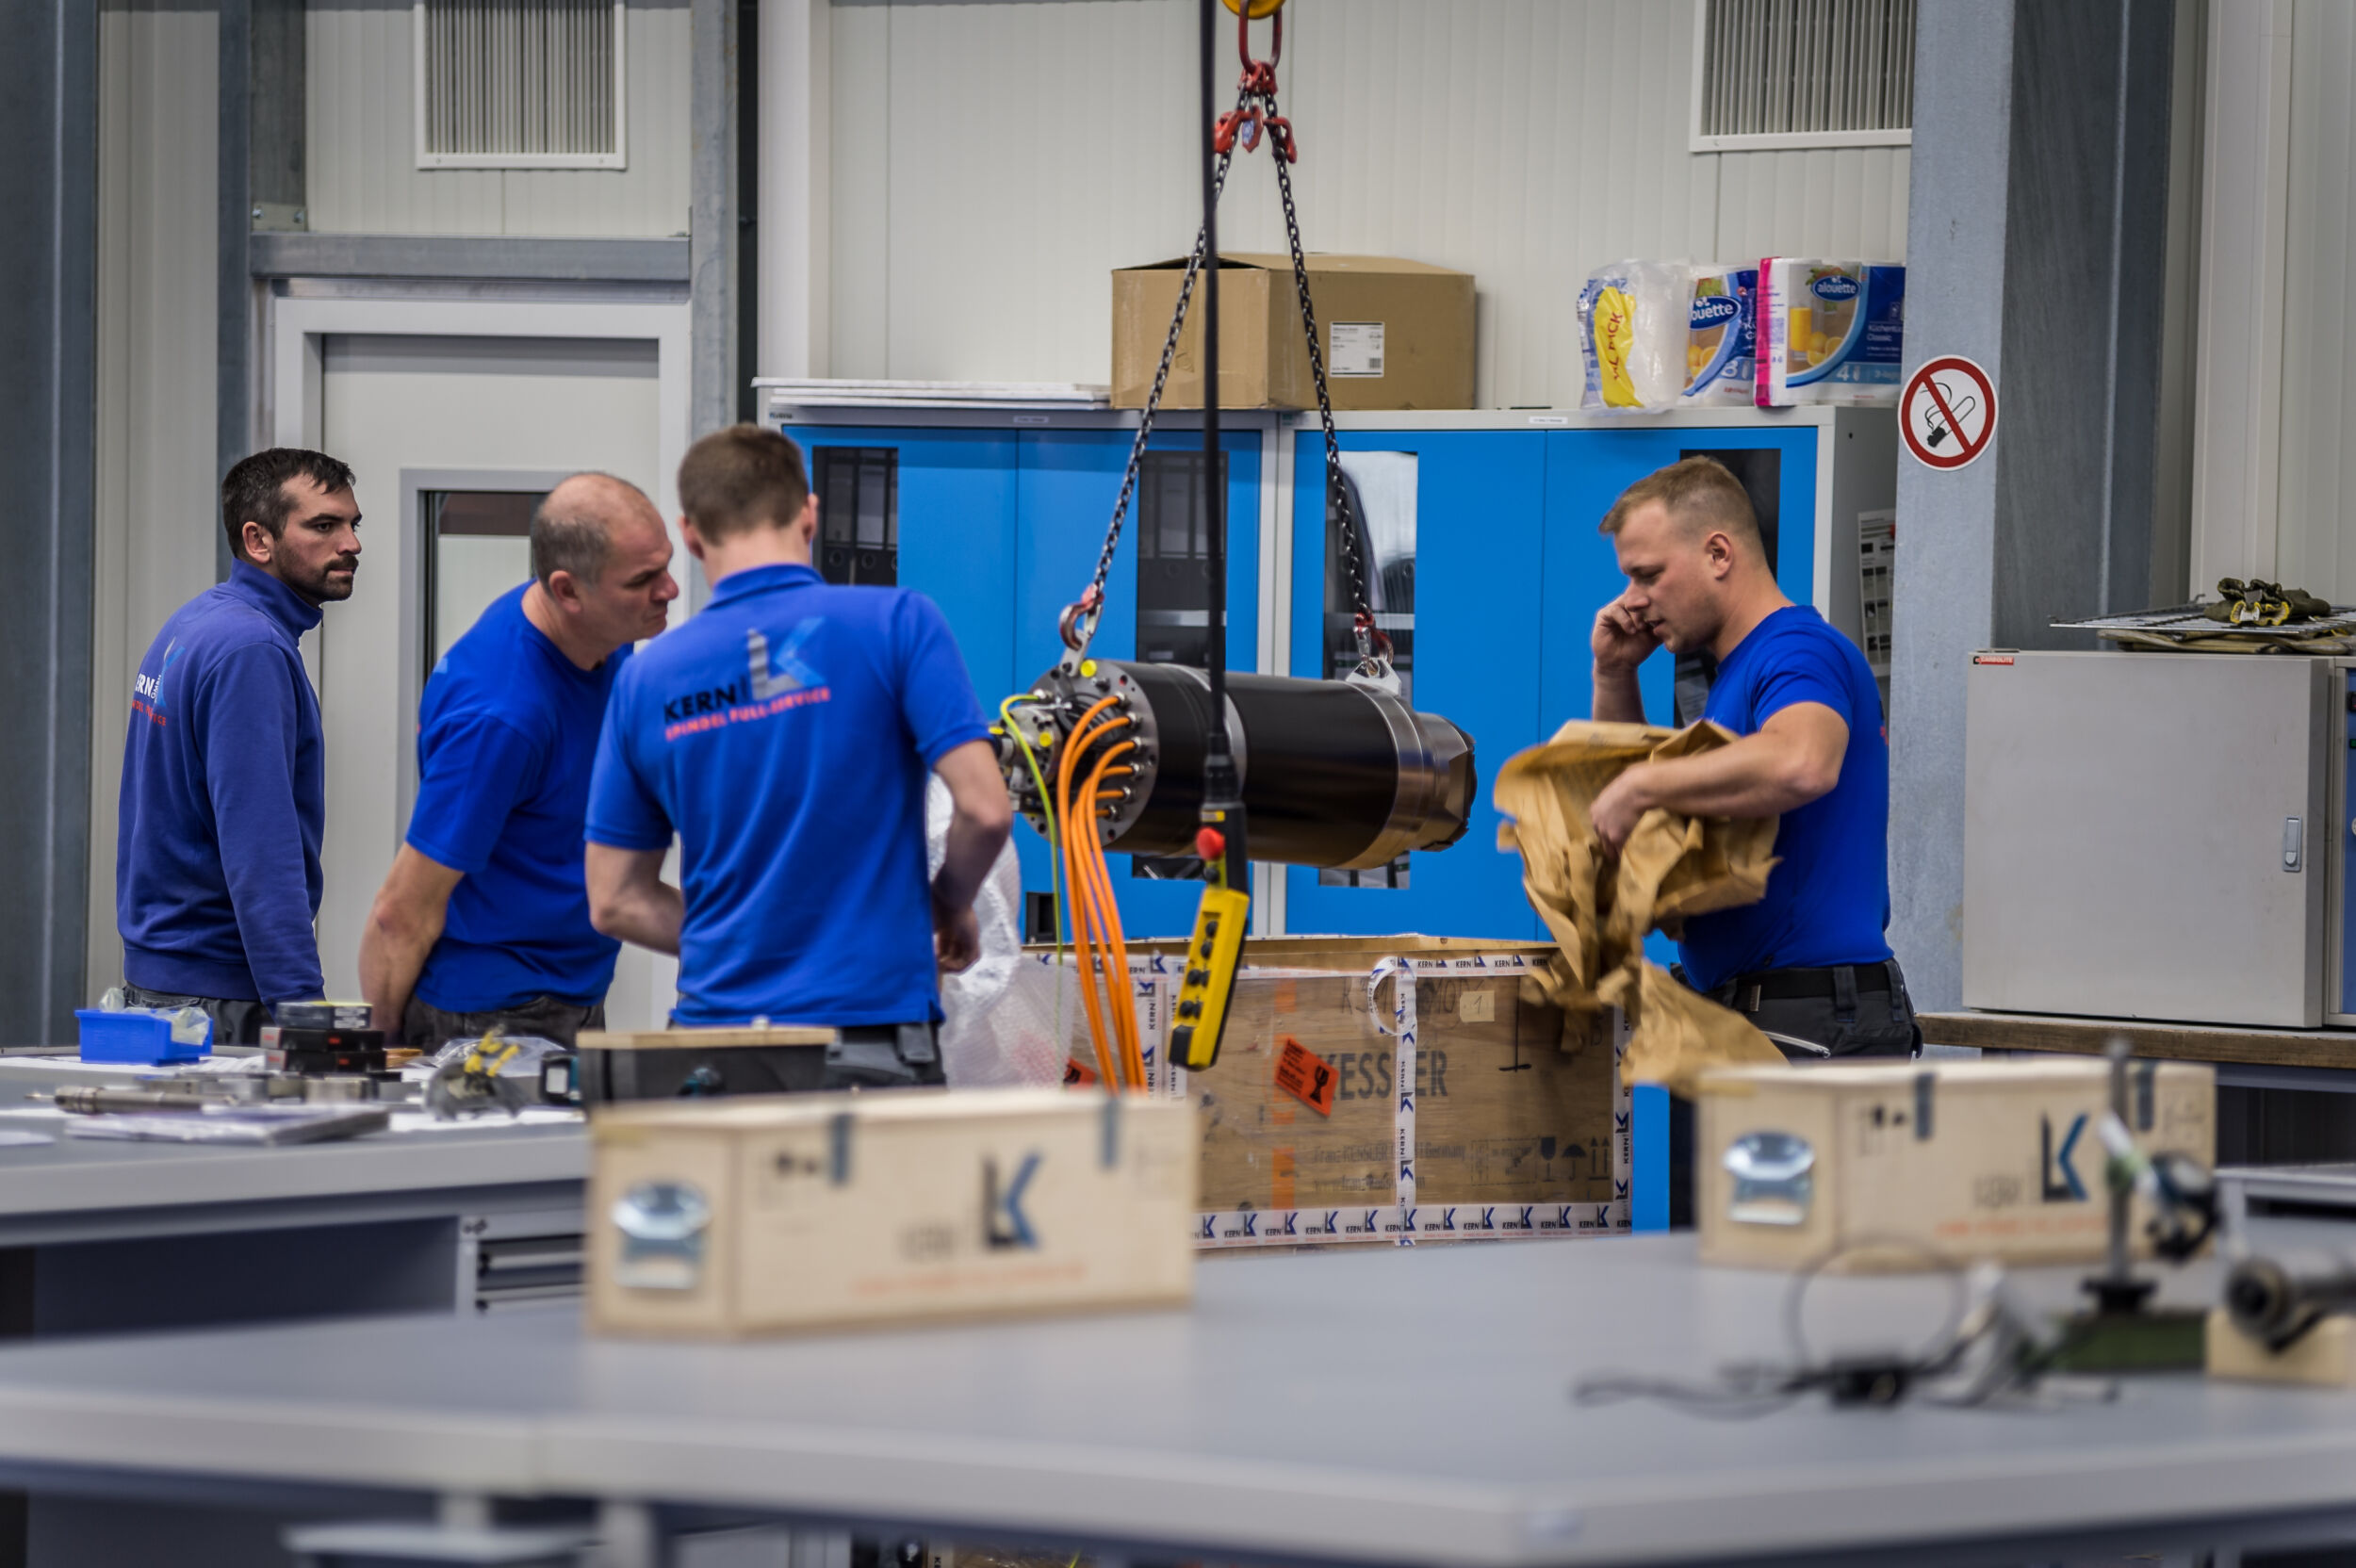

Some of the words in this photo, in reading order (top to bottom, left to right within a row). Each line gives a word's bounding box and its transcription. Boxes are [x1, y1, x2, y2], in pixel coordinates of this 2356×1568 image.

[1817, 283, 1857, 294] alouette
[1692, 303, 1734, 320] ouette
[136, 673, 155, 697] ERN
[663, 683, 737, 724] KERN
[665, 711, 727, 742] SPINDEL
[1417, 959, 1433, 969] KERN
[1455, 959, 1472, 969] KERN
[1495, 959, 1511, 968] KERN
[1318, 1050, 1448, 1102] ESSER
